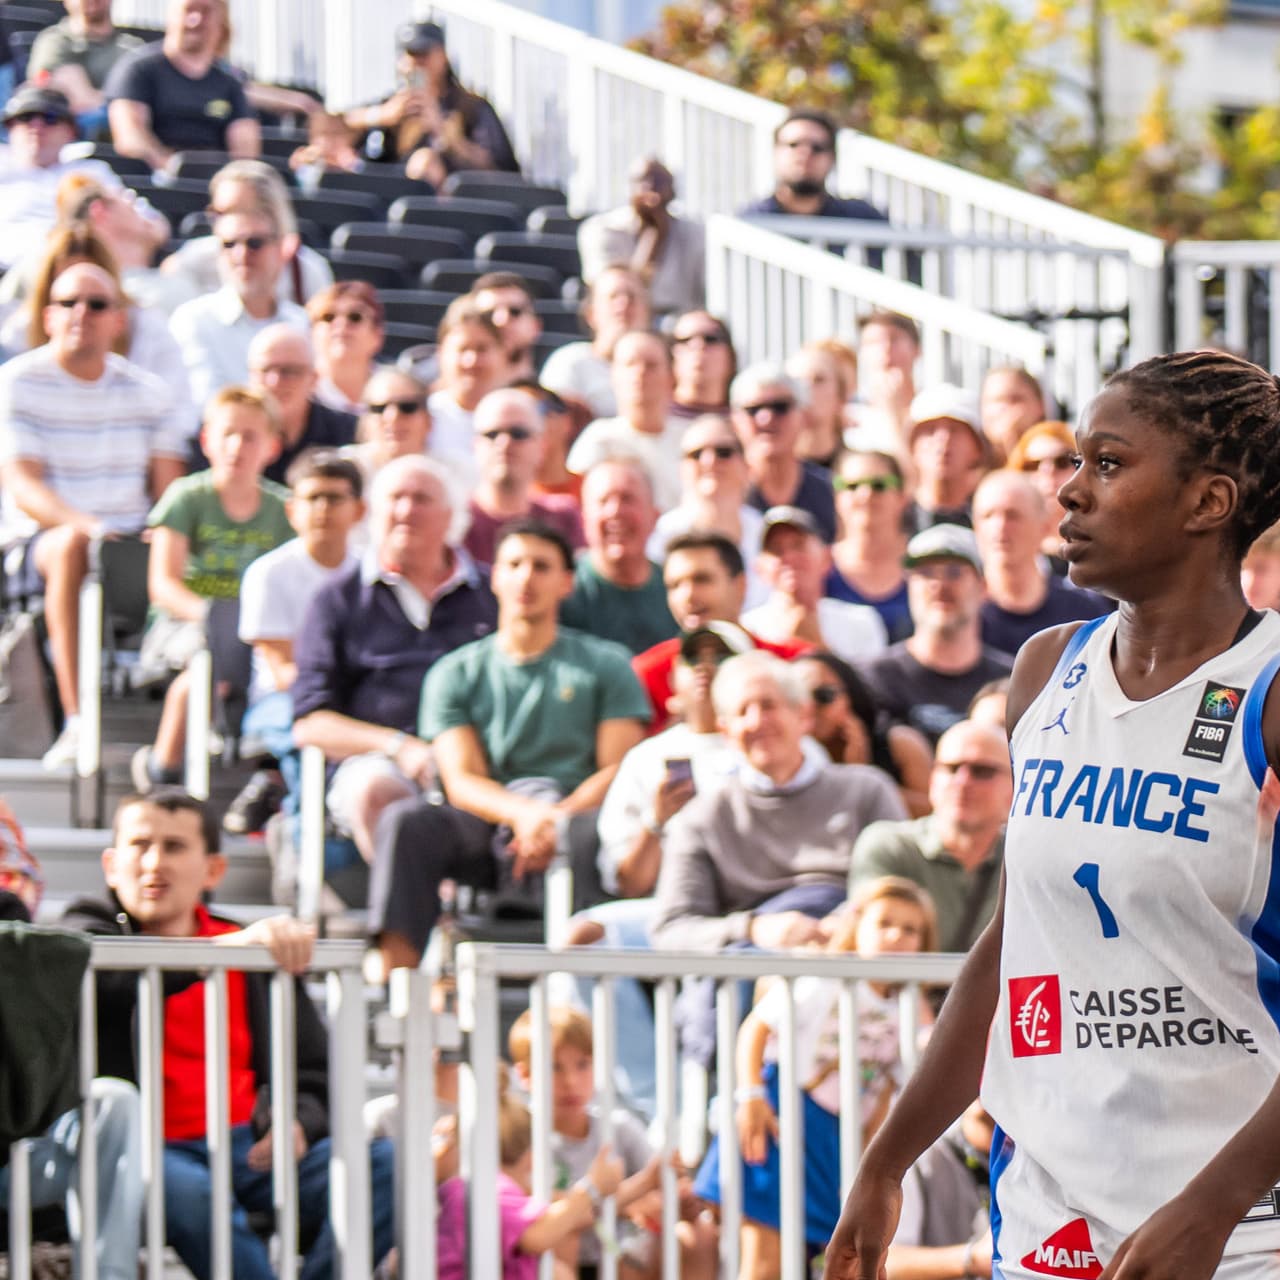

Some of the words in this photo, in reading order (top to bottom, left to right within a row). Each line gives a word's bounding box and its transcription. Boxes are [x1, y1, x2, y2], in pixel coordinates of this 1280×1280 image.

[1194, 725, 1225, 742] FIBA
[1011, 758, 1220, 843] FRANCE
[1073, 862, 1120, 939] 1
[1069, 985, 1186, 1017] CAISSE
[1034, 1245, 1098, 1269] MAIF
